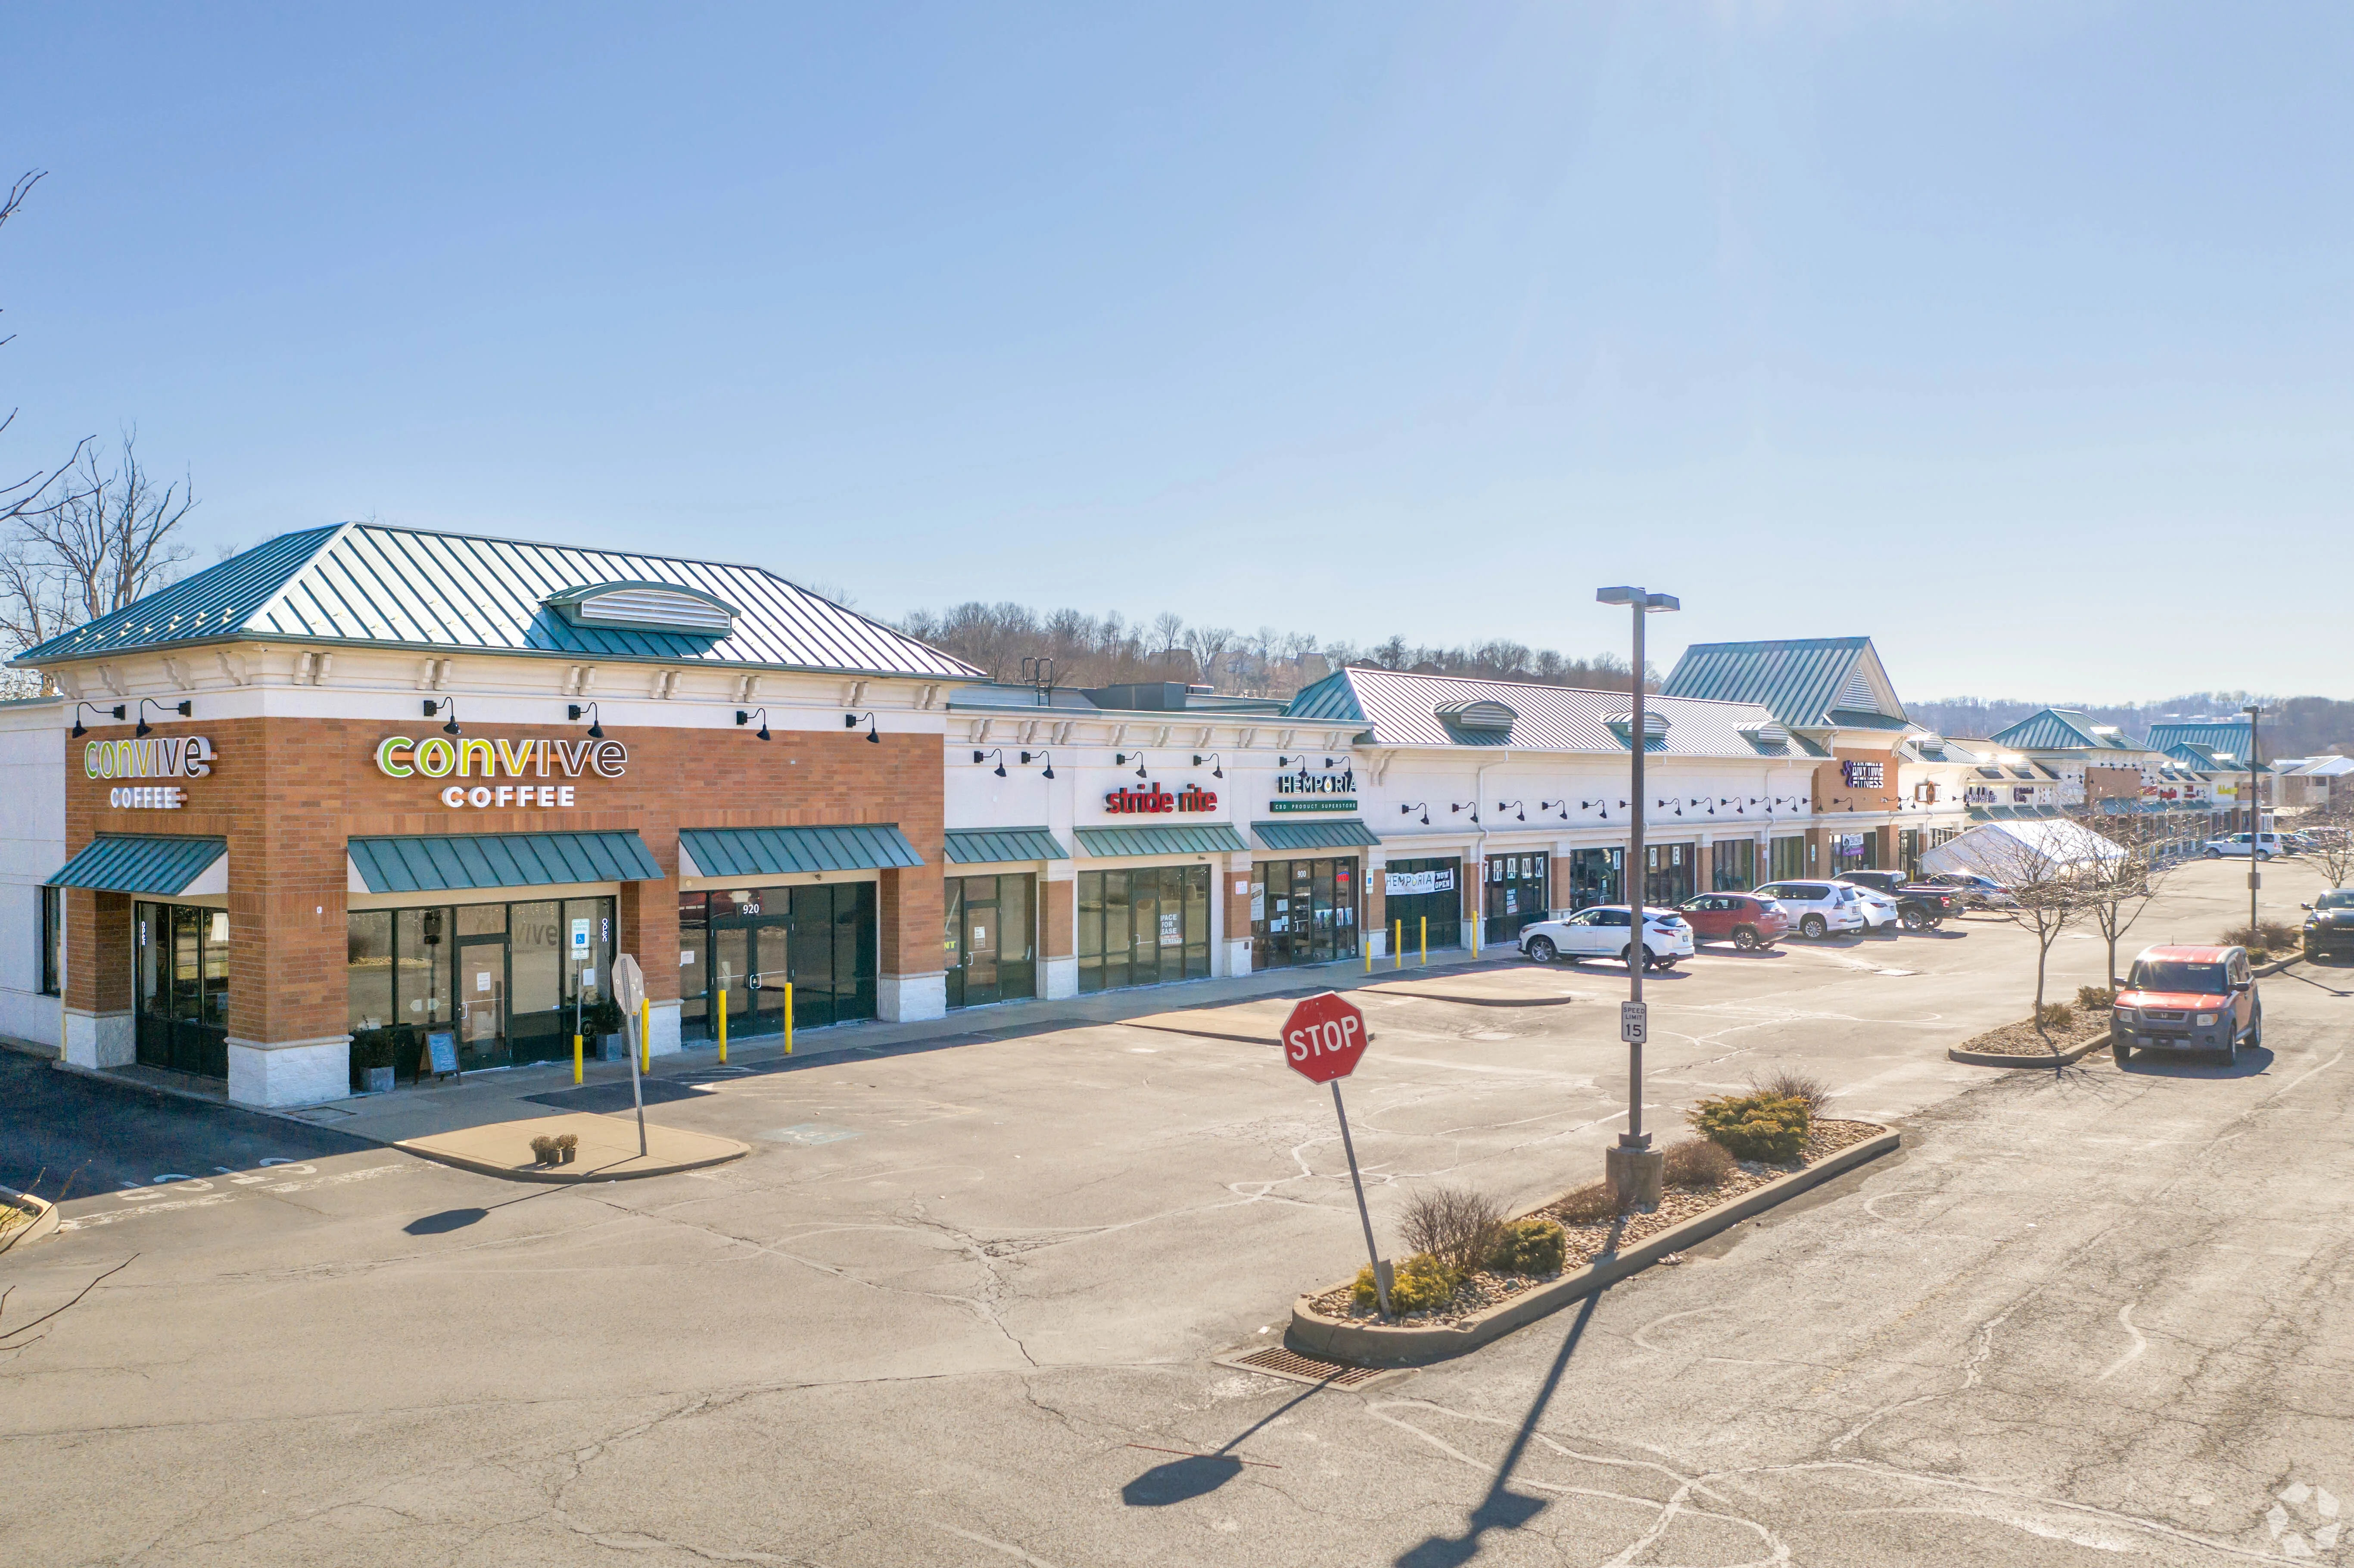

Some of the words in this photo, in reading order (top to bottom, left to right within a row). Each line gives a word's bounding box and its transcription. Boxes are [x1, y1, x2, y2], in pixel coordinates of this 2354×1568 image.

[84, 736, 212, 779] convive
[377, 736, 627, 778] convive
[1852, 762, 1884, 776] ANYTIME
[1280, 772, 1357, 793] HEMPORIA
[1853, 777, 1884, 788] FITNESS
[110, 787, 181, 809] COFFEE
[442, 786, 575, 808] COFFEE
[1106, 782, 1174, 813] stride
[1178, 783, 1217, 812] rite
[1437, 871, 1449, 880] NOW
[1485, 859, 1542, 879] HANK
[1386, 874, 1432, 887] HEMPORIA
[1435, 880, 1450, 889] OPEN
[743, 904, 760, 914] 920
[1289, 1015, 1358, 1061] STOP
[1626, 1024, 1642, 1037] 15
